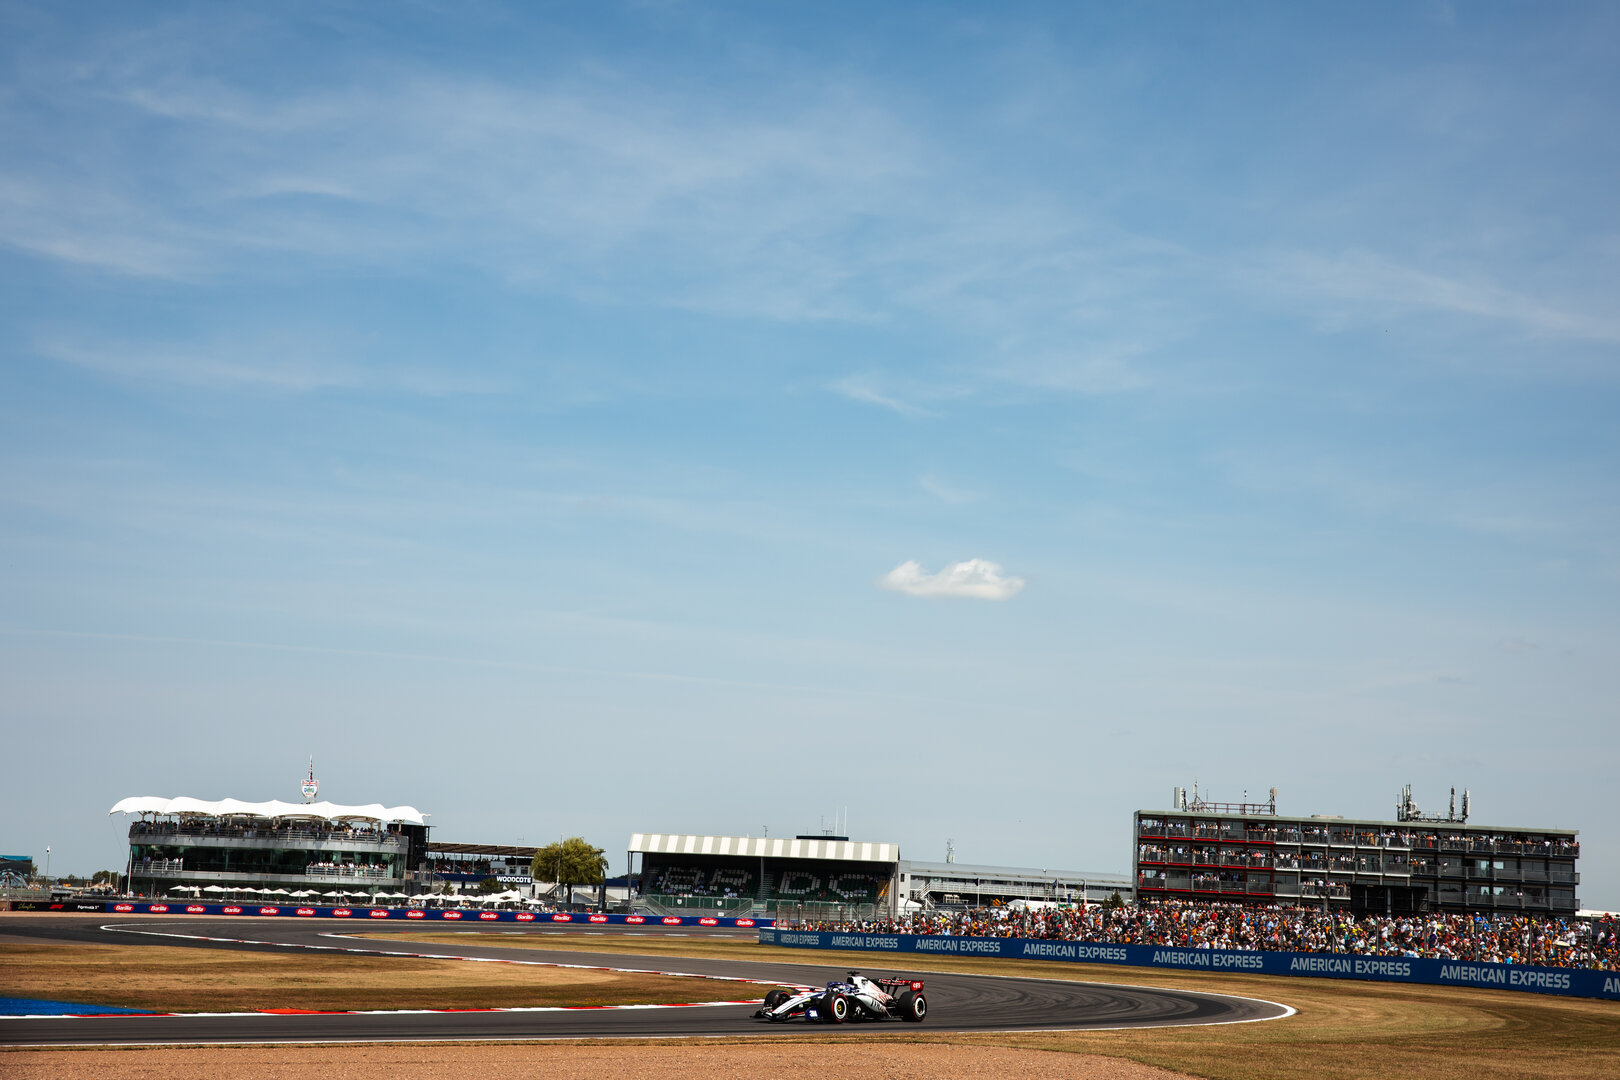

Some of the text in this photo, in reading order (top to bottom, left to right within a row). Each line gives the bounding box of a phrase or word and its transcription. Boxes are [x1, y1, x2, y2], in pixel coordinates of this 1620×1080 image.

[780, 933, 820, 945] AMERICAN EXPRESS
[831, 936, 898, 949] AMERICAN EXPRESS
[915, 939, 1001, 953] AMERICAN EXPRESS
[1023, 943, 1127, 960] AMERICAN EXPRESS
[1152, 951, 1263, 969] AMERICAN EXPRESS
[1290, 957, 1411, 977] AMERICAN EXPRESS
[1439, 965, 1571, 990] AMERICAN EXPRESS
